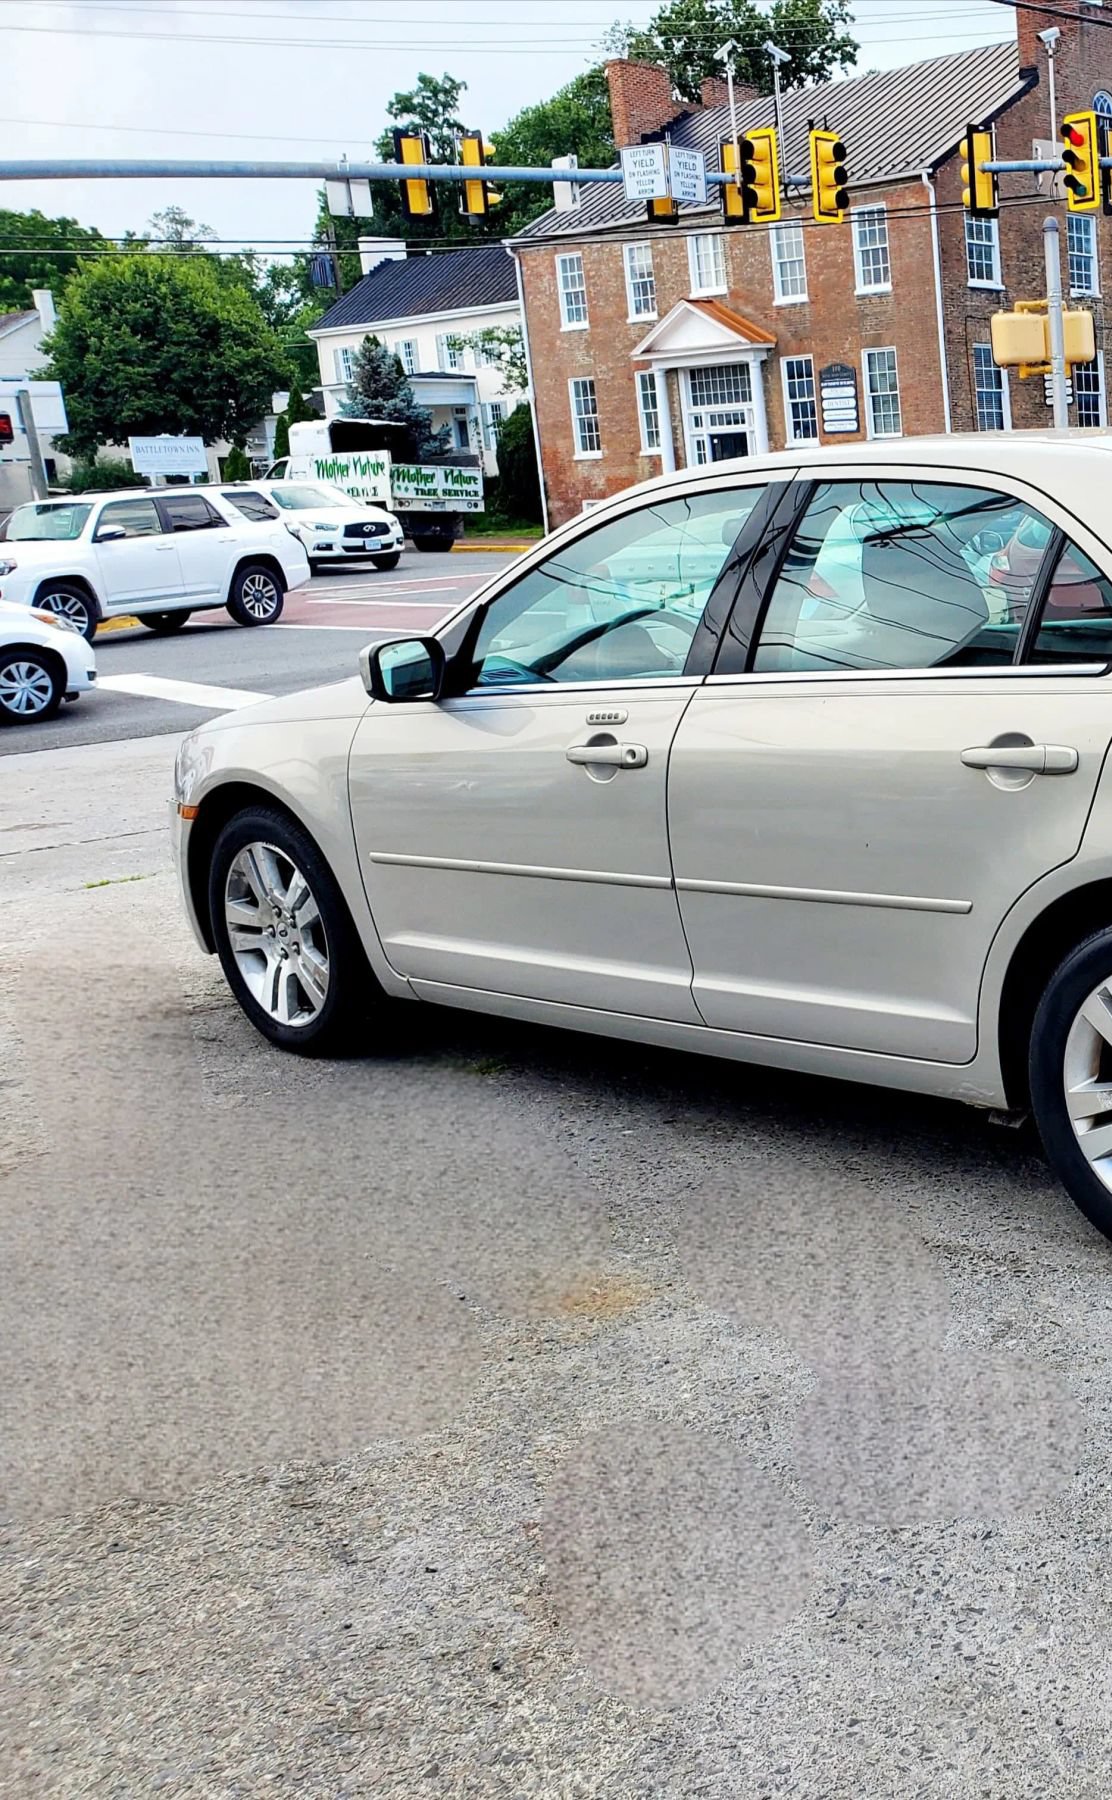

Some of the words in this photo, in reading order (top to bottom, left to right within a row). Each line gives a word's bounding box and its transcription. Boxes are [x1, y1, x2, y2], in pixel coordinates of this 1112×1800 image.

[642, 149, 655, 157] TURN
[632, 158, 655, 168] YIELD
[678, 161, 697, 171] YIELD
[636, 169, 660, 178] FLASHING
[681, 172, 702, 181] FLASHING
[682, 190, 696, 198] ARROW
[136, 445, 185, 454] BATTLETOWN
[186, 444, 200, 454] INN
[314, 456, 350, 483] Mother
[352, 455, 386, 481] Nature
[393, 467, 436, 486] Mother
[444, 468, 479, 487] Nature
[414, 488, 438, 496] TREE
[442, 488, 480, 498] SERVICE
